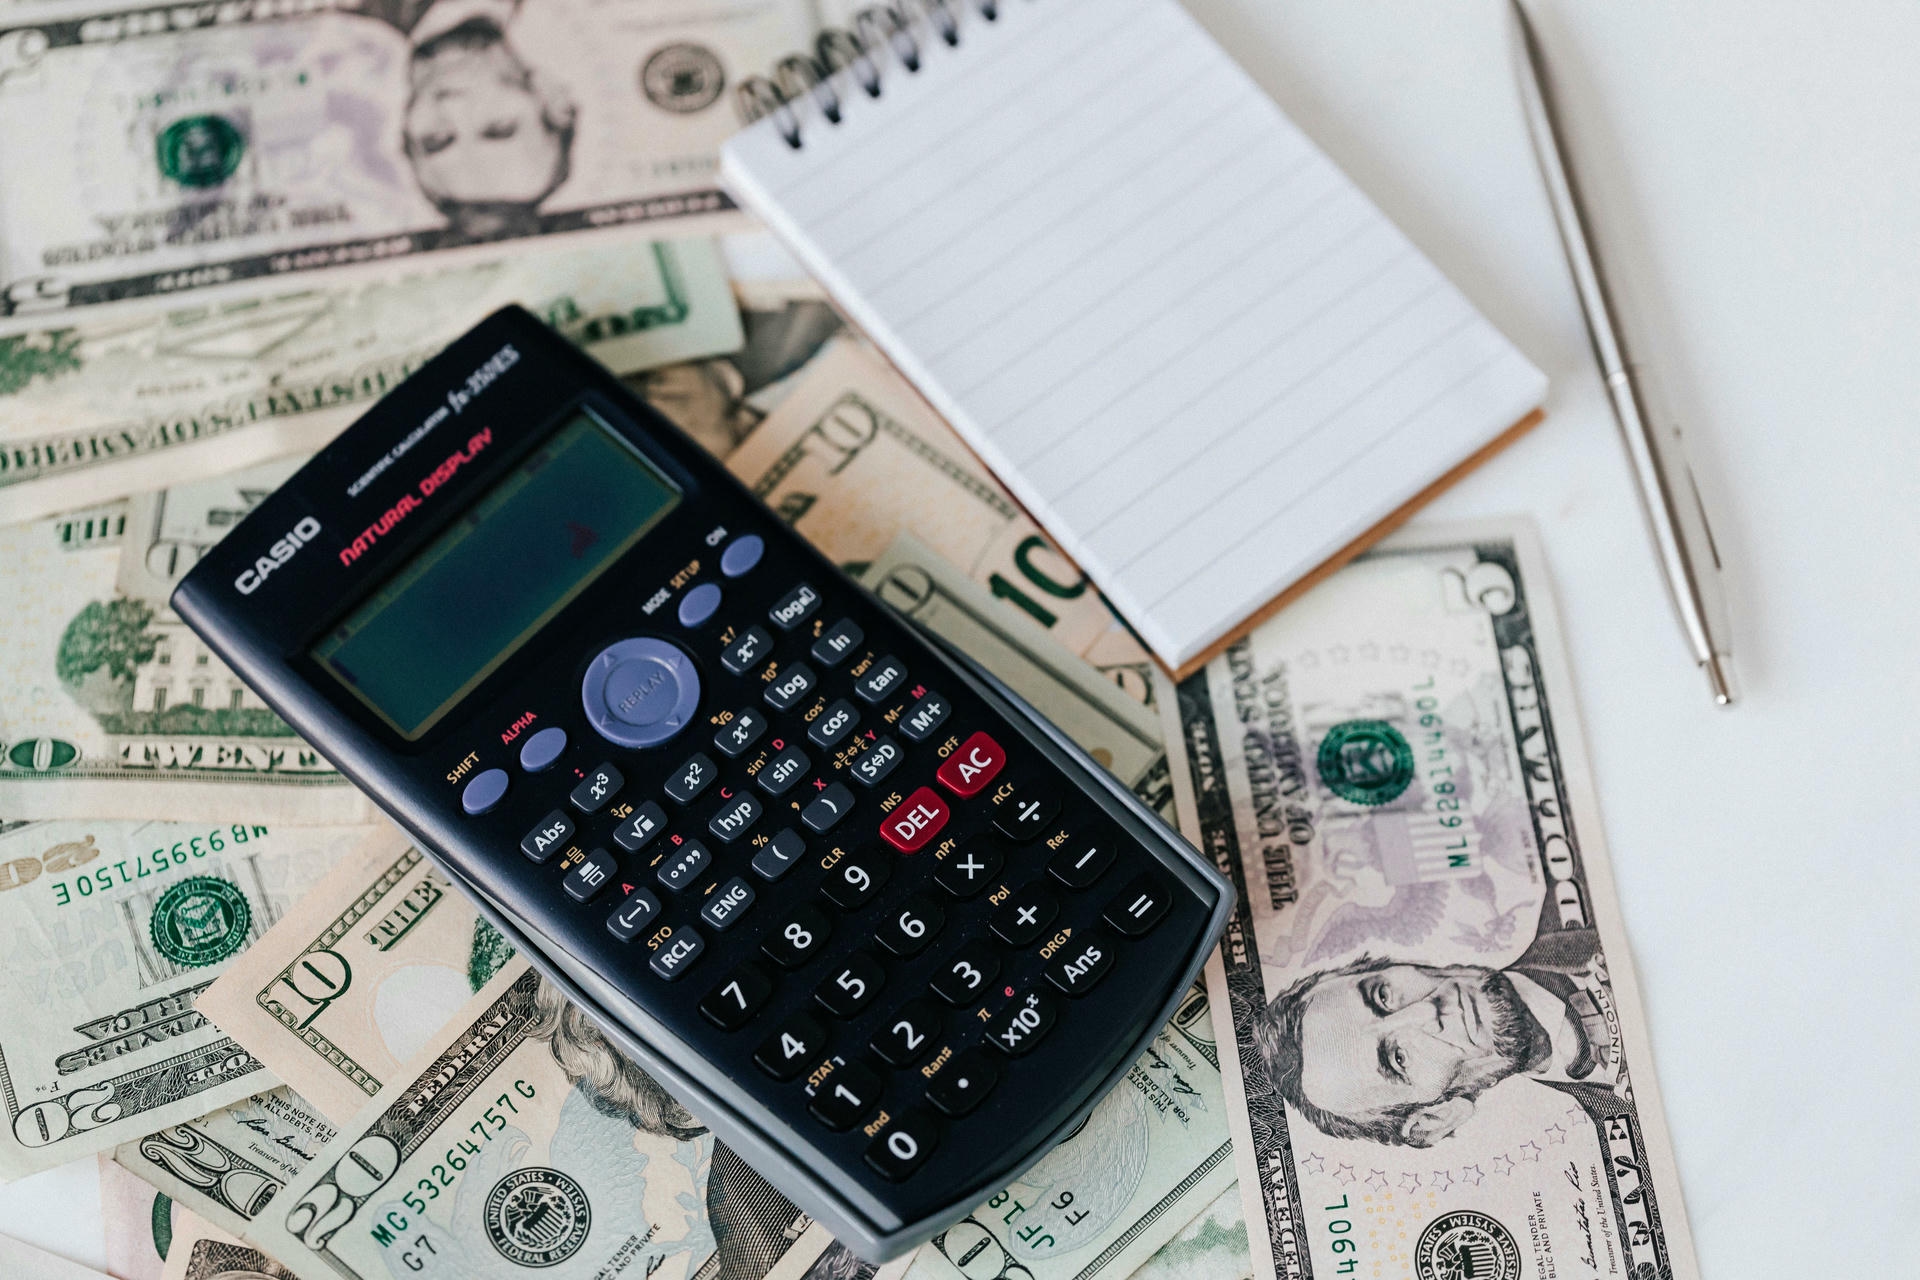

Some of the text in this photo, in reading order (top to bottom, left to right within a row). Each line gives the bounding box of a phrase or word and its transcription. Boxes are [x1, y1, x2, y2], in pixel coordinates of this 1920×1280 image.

[338, 426, 493, 567] NATURAL DISPLAY
[705, 526, 727, 547] ON
[235, 516, 322, 596] CASIO
[642, 560, 701, 614] MODE SETUP
[988, 533, 1087, 629] 10
[828, 633, 850, 652] ln
[619, 672, 666, 714] REPLAY
[775, 673, 808, 700] log
[868, 666, 898, 692] tan
[911, 684, 927, 699] M
[500, 710, 537, 745] ALPHA
[822, 710, 849, 736] cos
[910, 701, 941, 731] M+
[772, 738, 785, 751] D
[864, 729, 877, 741] Y
[937, 736, 960, 759] OFF
[446, 751, 480, 784] SHIFT
[772, 757, 798, 783] sin
[957, 747, 993, 784] AC
[1191, 721, 1215, 794] NOTE
[720, 787, 733, 799] C
[813, 777, 827, 792] X
[991, 781, 1016, 805] nCr
[717, 801, 752, 831] hyp
[879, 791, 902, 813] INS
[534, 820, 566, 852] Abs
[895, 803, 940, 841] DEL
[671, 834, 683, 846] B
[934, 837, 956, 861] nPr
[1046, 829, 1070, 851] Rec
[1445, 835, 1471, 868] ML
[75, 829, 226, 898] 93957150
[820, 846, 845, 871] CLR
[622, 882, 634, 895] A
[844, 865, 870, 891] 9
[52, 882, 71, 906] E
[711, 885, 747, 920] ENG
[989, 885, 1010, 907] Pol
[647, 926, 673, 951] STO
[784, 923, 812, 949] 8
[899, 911, 926, 938] 6
[660, 937, 696, 969] RCL
[1063, 945, 1102, 984] Ans
[836, 969, 866, 999] 5
[952, 960, 982, 988] 3
[721, 980, 747, 1009] 7
[1004, 985, 1015, 997] e
[892, 1020, 925, 1050] 2
[1595, 988, 1621, 1064] LINCOLN
[780, 1032, 806, 1059] 4
[403, 1010, 518, 1117] FEDERAL
[835, 1084, 861, 1107] 1
[1149, 1094, 1167, 1113] THIS
[1160, 1090, 1174, 1106] ALL
[12, 1080, 123, 1149] 20
[264, 1103, 282, 1117] ALL
[270, 1095, 326, 1130] THIS NOTE IS
[863, 1110, 890, 1138] Rnd
[1173, 1106, 1190, 1123] FOR
[248, 1142, 280, 1166] Treasurer
[888, 1131, 918, 1160] 0
[370, 1079, 536, 1248] MG 53264757 G
[286, 1135, 402, 1252] 20
[489, 1172, 544, 1229] UNITED STATES
[1595, 1189, 1606, 1215] United
[498, 1177, 586, 1263] FEDERAL RESERVE SYSTEM
[1051, 1191, 1090, 1227] F6
[1533, 1191, 1549, 1232] PRIVATE
[1599, 1216, 1609, 1229] the
[1449, 1215, 1496, 1234] SYSTEM
[1528, 1214, 1541, 1253] TENDER
[1603, 1228, 1612, 1239] of
[608, 1235, 638, 1267] TENDER
[615, 1256, 631, 1274] AND
[630, 1223, 661, 1256] PRIVATE
[1421, 1227, 1442, 1264] STATES
[1541, 1234, 1551, 1253] AND
[1607, 1237, 1618, 1275] Treasurer
